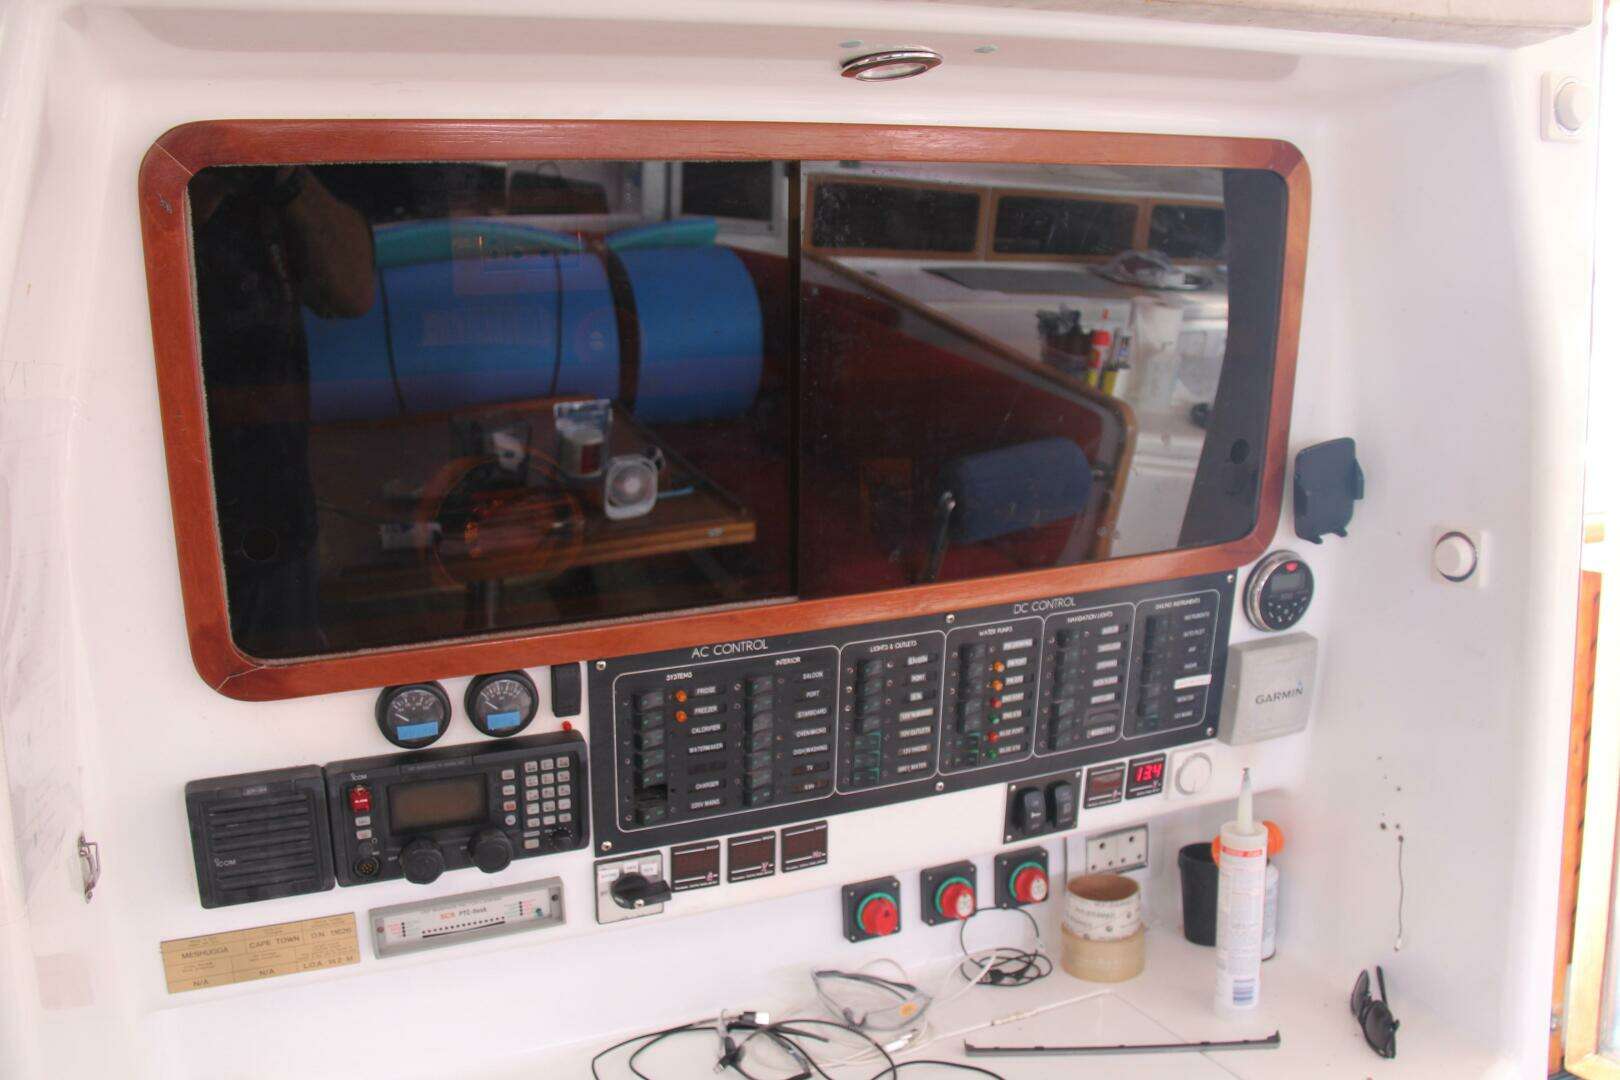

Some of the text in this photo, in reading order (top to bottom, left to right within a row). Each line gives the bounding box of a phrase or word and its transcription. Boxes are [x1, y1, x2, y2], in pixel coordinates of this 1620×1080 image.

[1014, 596, 1077, 615] DC CONTROL
[691, 639, 769, 659] AC CONTROL
[895, 640, 918, 649] OUTLETS
[775, 656, 801, 666] INTERIOR
[665, 671, 693, 681] SYSTEMS
[802, 670, 825, 681] SALOON
[1254, 687, 1304, 705] GARMIN
[693, 705, 719, 716] FREEZER
[795, 707, 828, 719] STARBOARD
[688, 742, 724, 754] WATERMAKER
[694, 780, 720, 790] CHARGER
[704, 798, 721, 807] MAINS
[249, 934, 301, 950] CAPE TOWN
[258, 967, 275, 977] N/A
[192, 978, 209, 988] N/A
